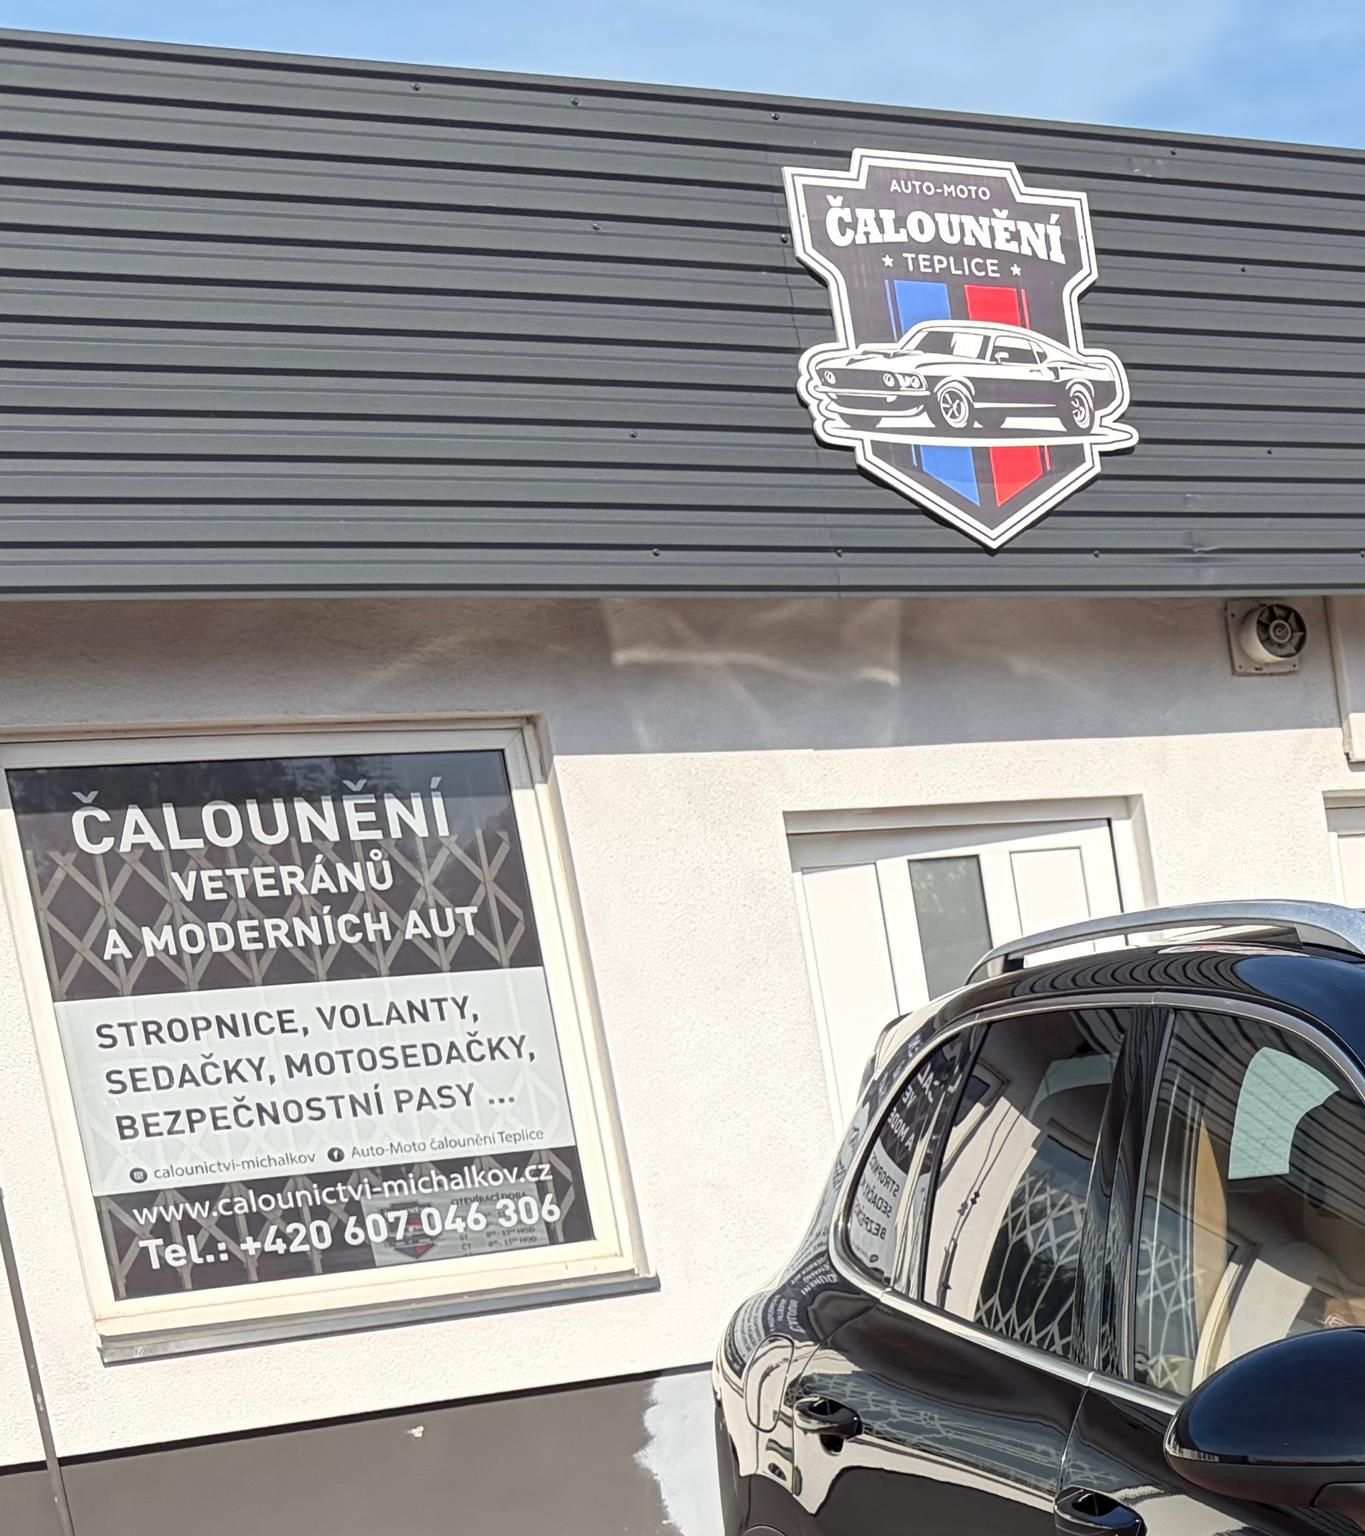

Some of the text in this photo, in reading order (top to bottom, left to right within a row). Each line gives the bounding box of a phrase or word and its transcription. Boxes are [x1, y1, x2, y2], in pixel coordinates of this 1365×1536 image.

[889, 178, 992, 200] AUTO-MOTO
[825, 194, 1067, 265] ČALOUNĚNÍ
[902, 252, 1001, 278] TEPLICE
[71, 775, 451, 855] ČALOUNĚNÍ
[171, 849, 394, 902] VETERÁNŮ
[102, 905, 479, 960] A MODERNÍCH AUT
[95, 995, 480, 1050] STROPNICE, VOLANTY,
[104, 1031, 537, 1095] SEDAČKY, MOTOSEDAČKY,
[115, 1084, 385, 1141] BEZPEČNOSTNÍ
[393, 1083, 476, 1114] PASY
[153, 1150, 317, 1180] calounictvi-michalkov
[350, 1126, 545, 1159] Auto-Moto čalounění Teplice
[132, 1161, 554, 1227] www.calounictvi-michalkov.cz
[138, 1236, 229, 1271] Tel.:
[240, 1220, 333, 1258] +420
[343, 1209, 409, 1246] 607
[420, 1200, 487, 1236] 046
[495, 1193, 561, 1228] 306
